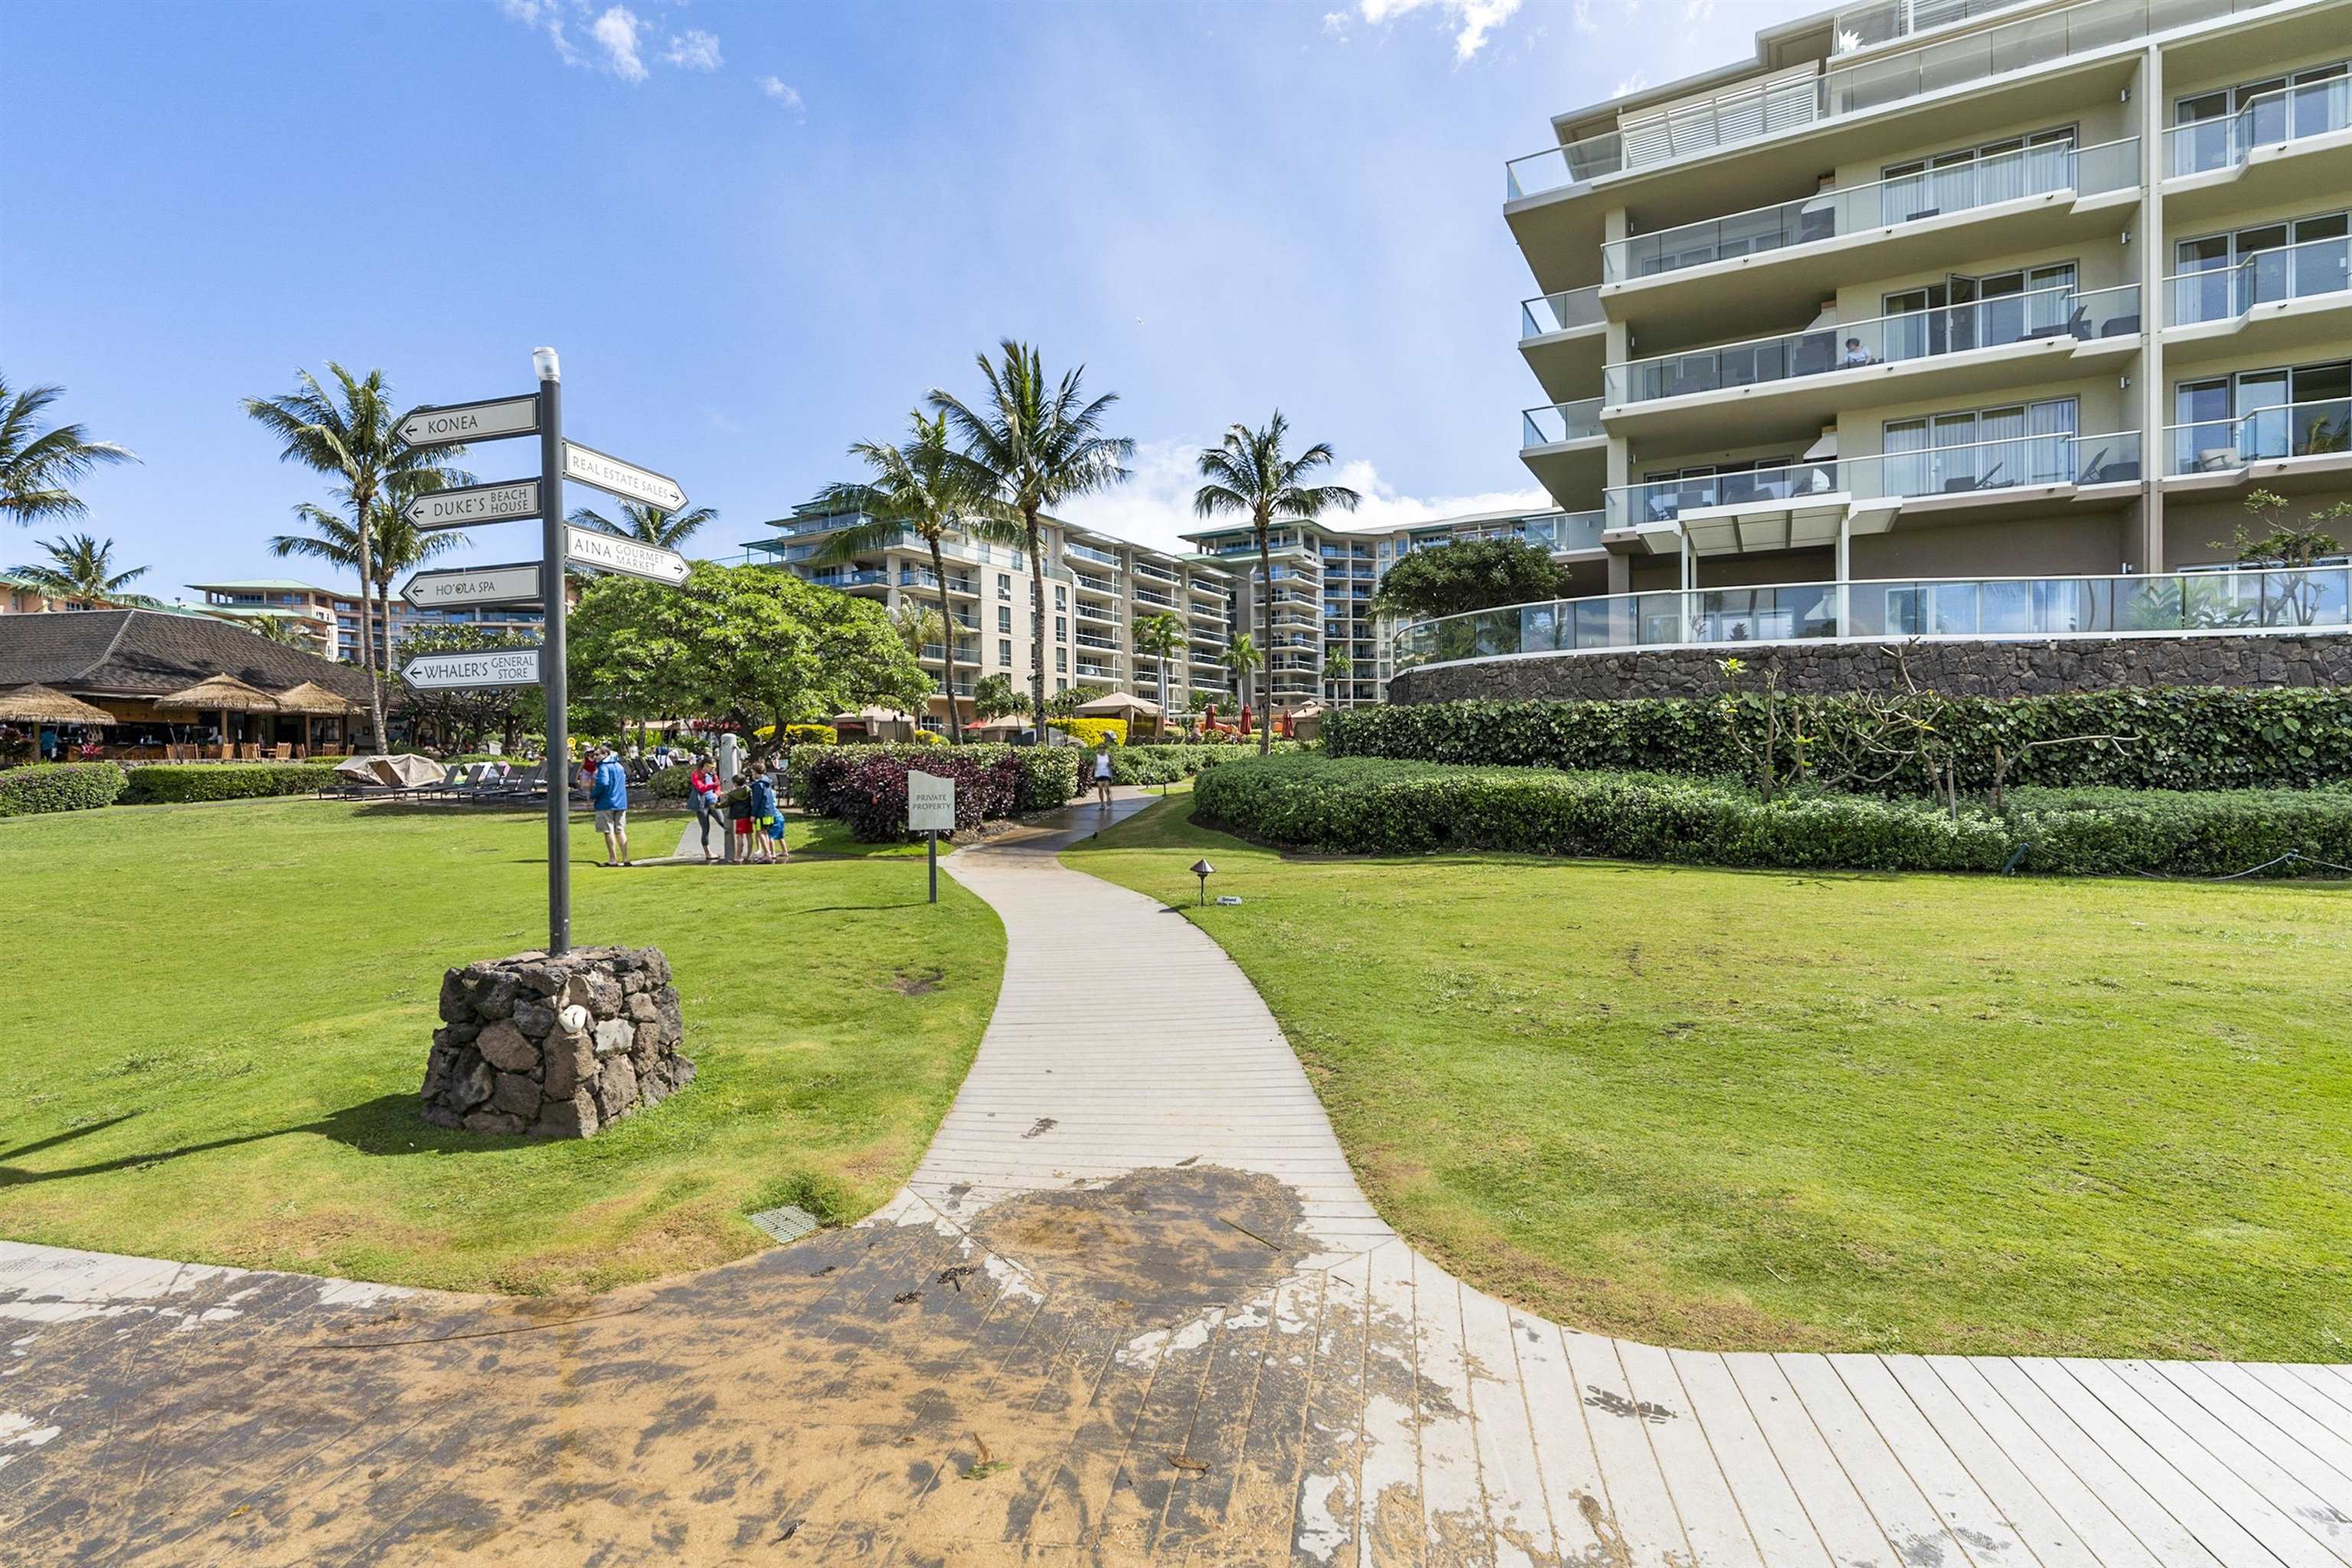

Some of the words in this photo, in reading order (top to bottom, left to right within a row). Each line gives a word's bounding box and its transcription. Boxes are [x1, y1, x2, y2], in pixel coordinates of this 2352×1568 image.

[428, 415, 479, 434] KONEA
[573, 456, 600, 475] REAL
[603, 466, 639, 488] ESTATE
[642, 480, 668, 498] SALES
[491, 488, 527, 502] BEACH
[434, 498, 485, 517] DUKE'S
[491, 499, 528, 514] HOUSE
[574, 538, 612, 558] AINA
[615, 544, 665, 564] GOURMET
[616, 555, 656, 572] MARKET
[479, 581, 495, 593] SPA
[424, 662, 488, 679] WHALER'S
[491, 656, 534, 668] GENERAL
[498, 668, 528, 680] STORE
